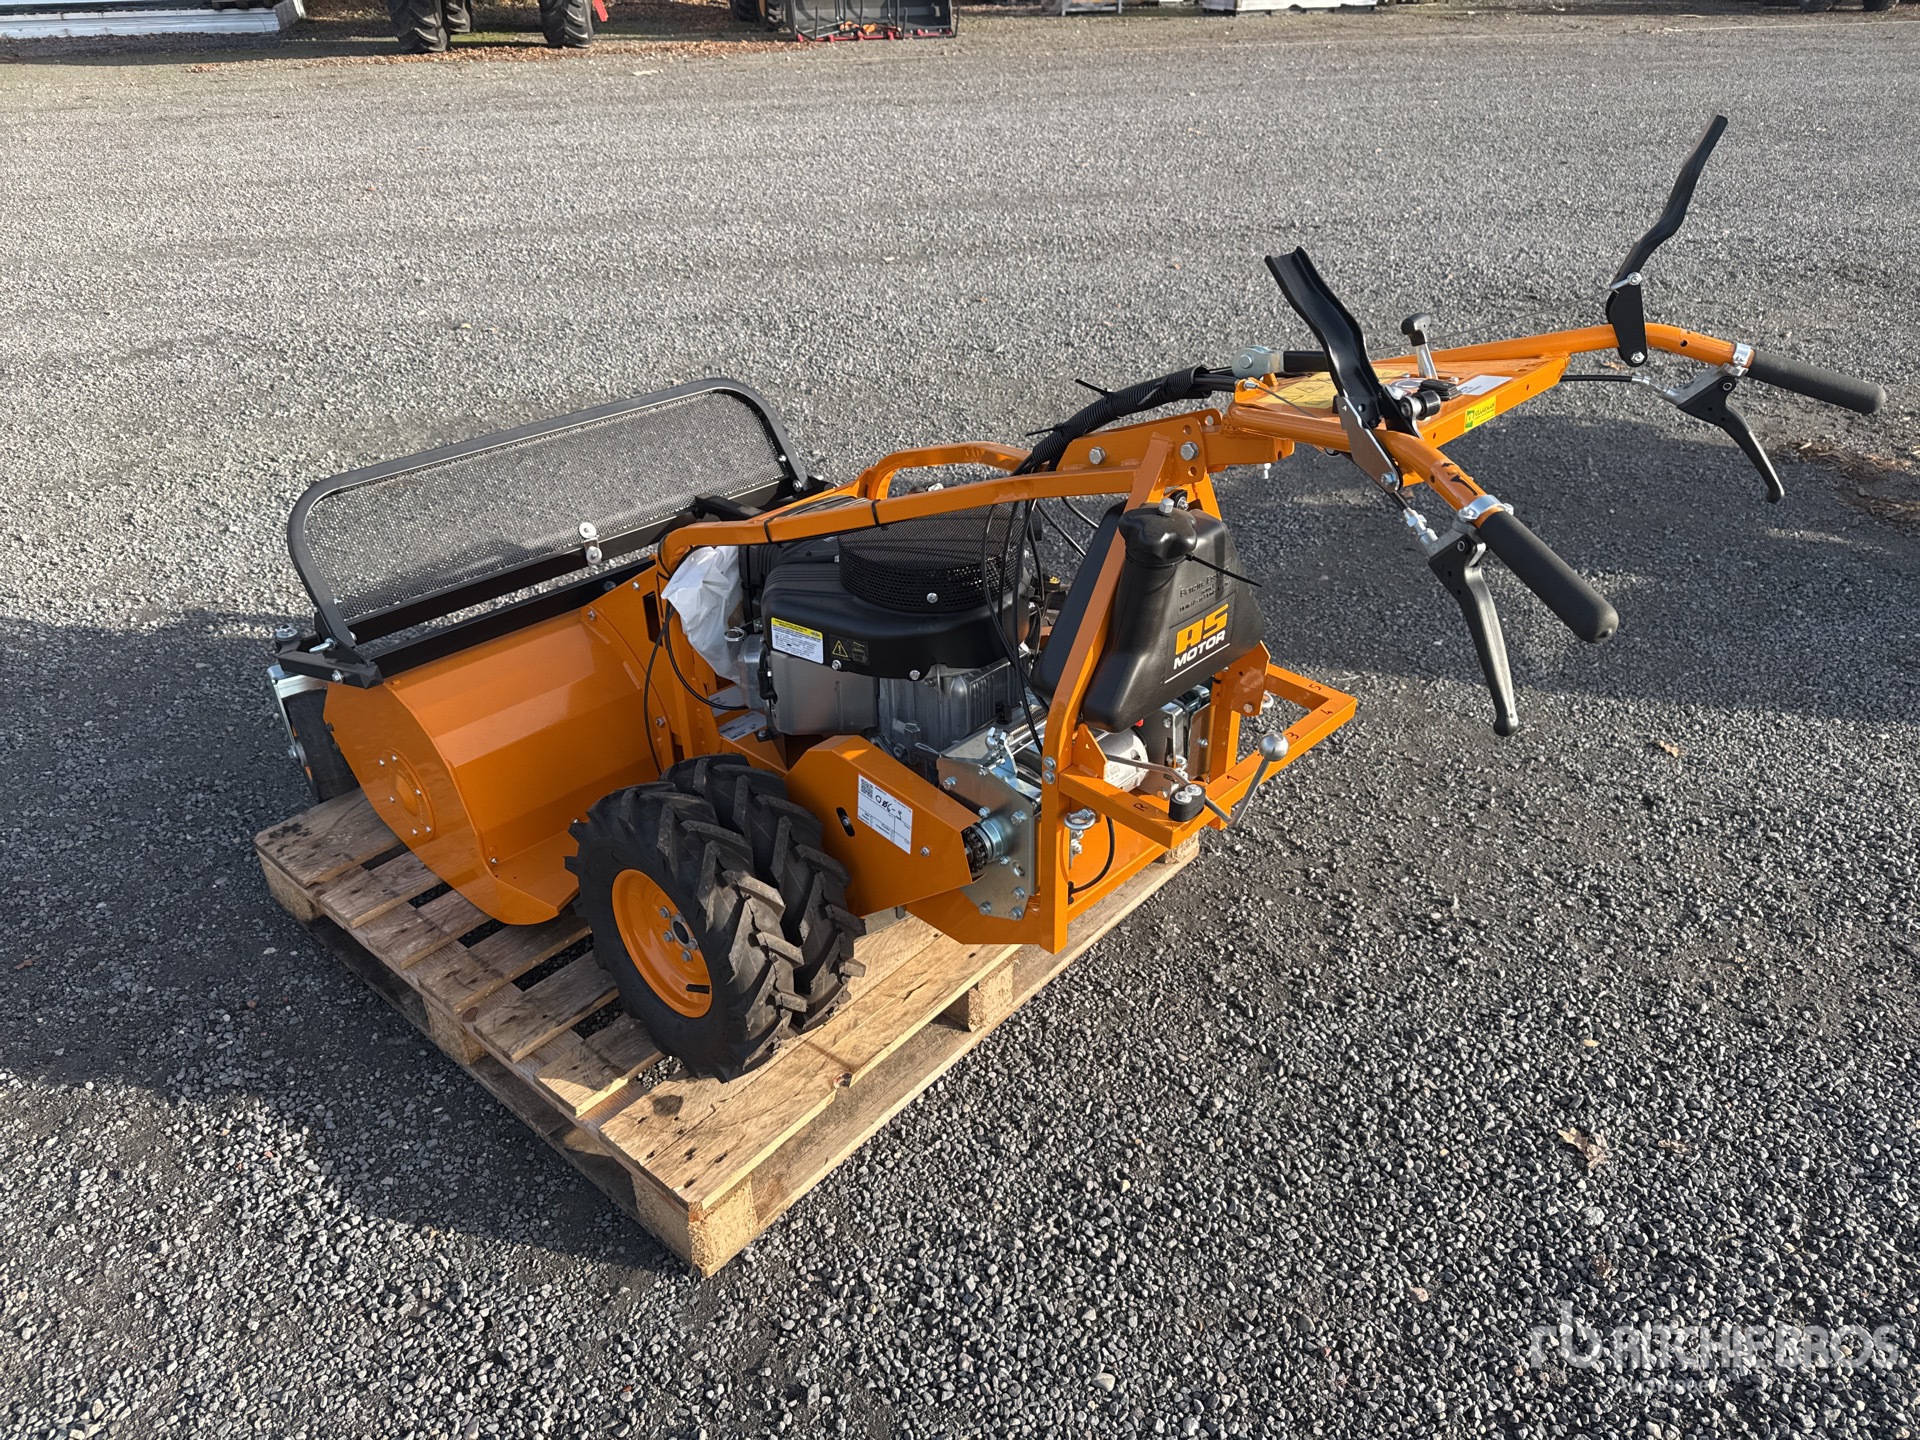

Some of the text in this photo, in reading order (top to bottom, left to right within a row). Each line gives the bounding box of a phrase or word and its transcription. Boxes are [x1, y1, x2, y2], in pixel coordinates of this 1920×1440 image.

[1175, 604, 1229, 655] AS
[1173, 630, 1226, 670] MOTOR
[1320, 708, 1333, 716] 4
[1285, 731, 1299, 740] 3
[1226, 774, 1239, 782] 1
[1133, 802, 1149, 812] R
